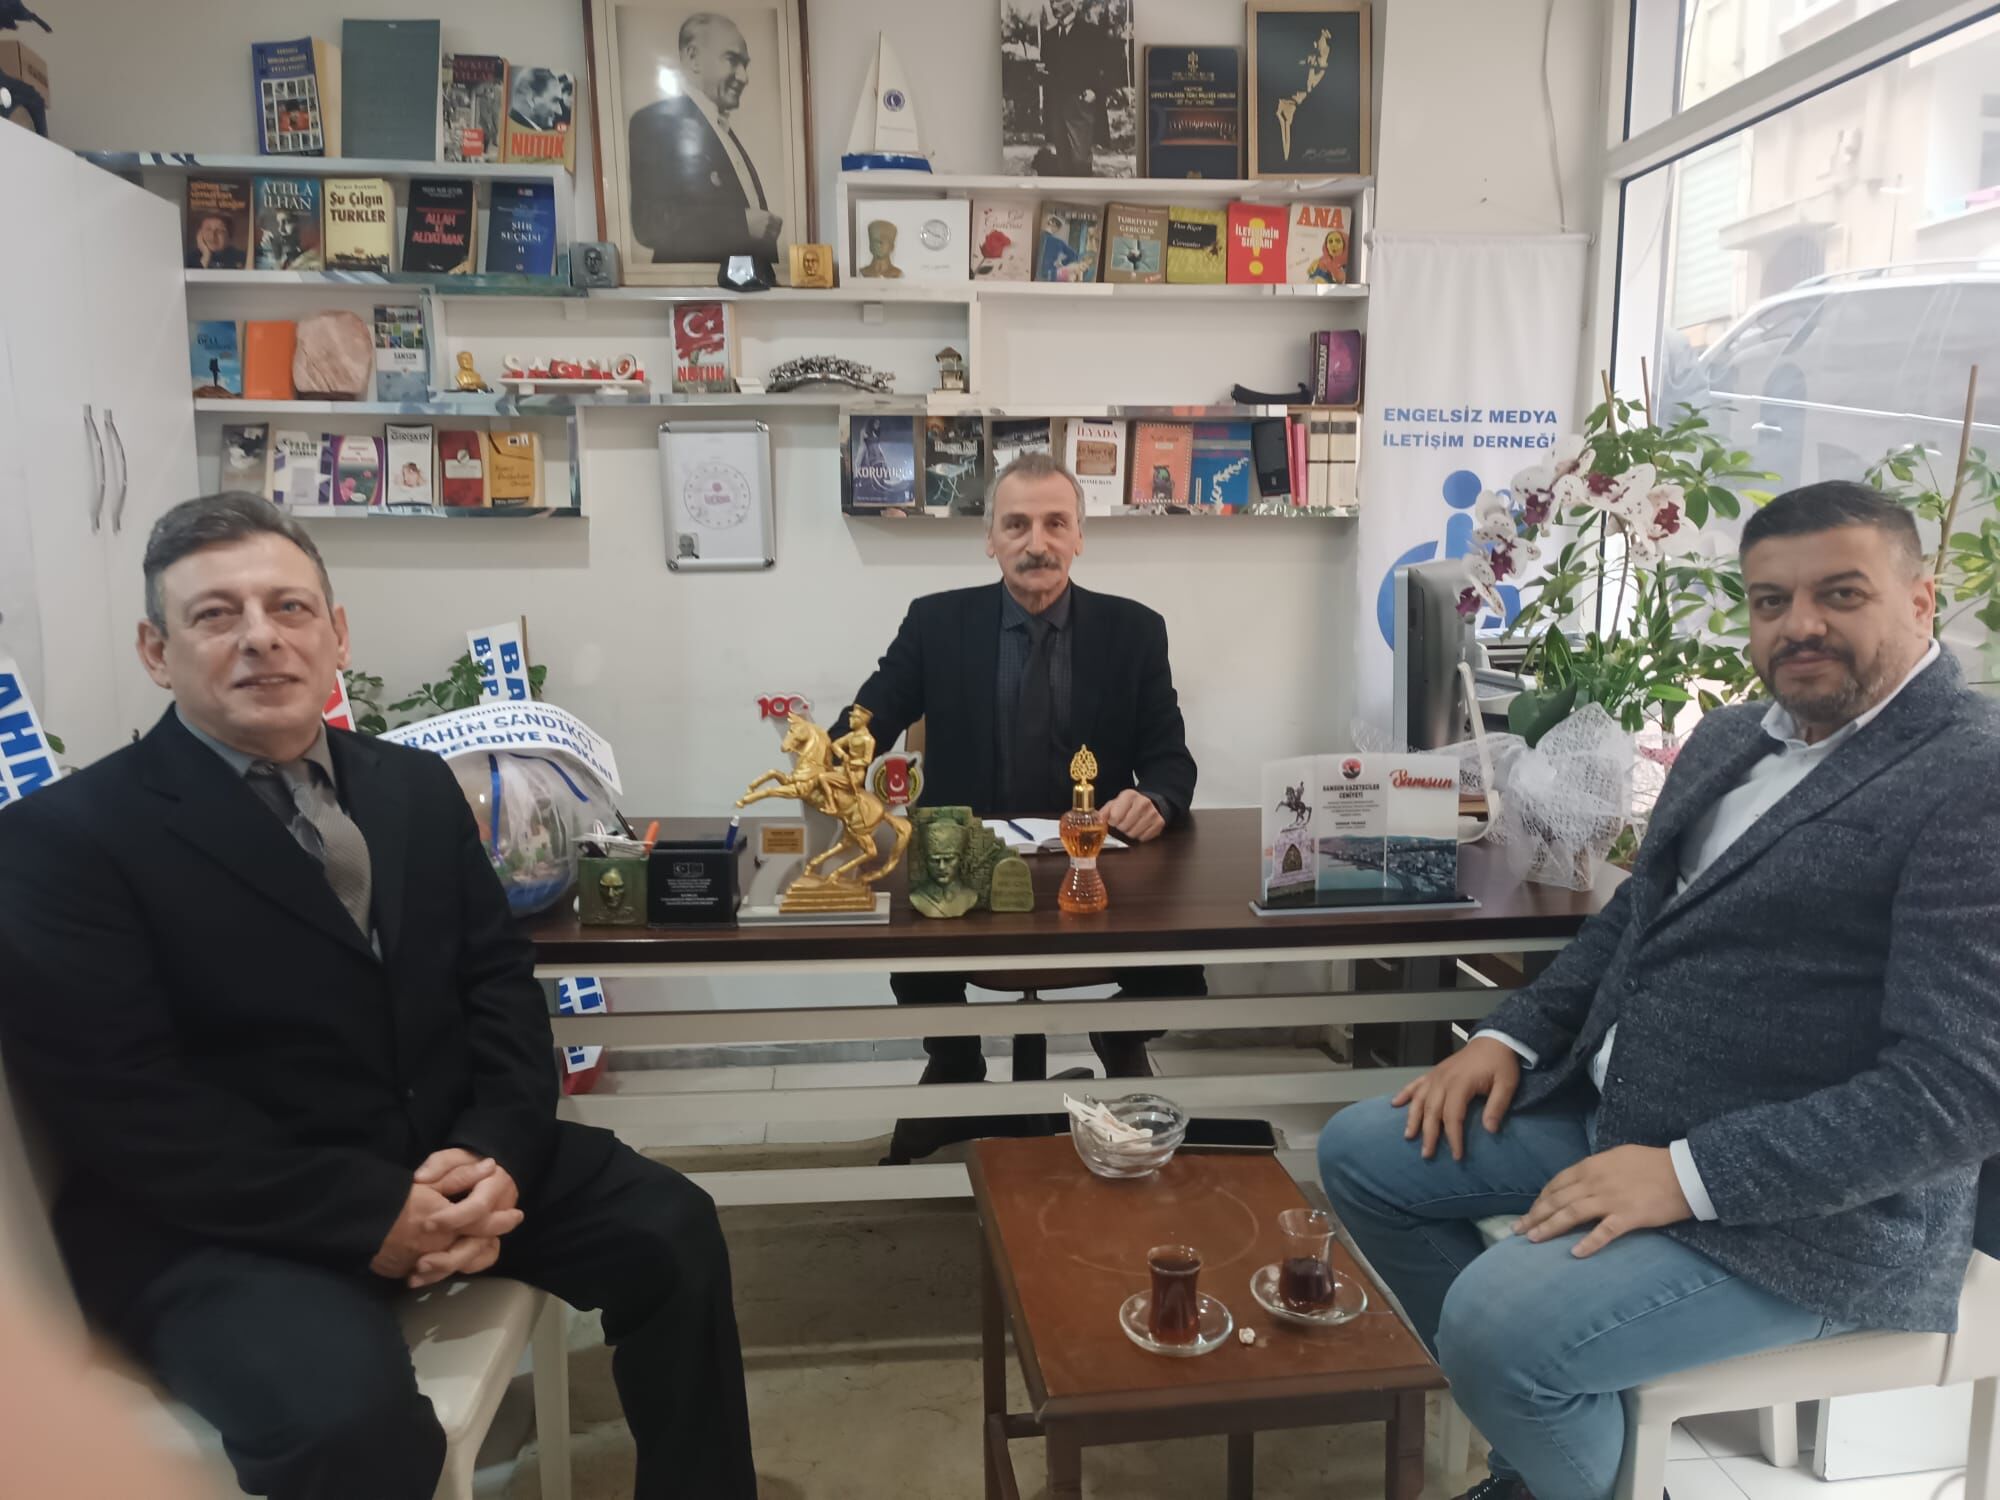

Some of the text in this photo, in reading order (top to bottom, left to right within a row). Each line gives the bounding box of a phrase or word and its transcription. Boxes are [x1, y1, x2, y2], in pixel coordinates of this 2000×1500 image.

[511, 133, 564, 159] NUTUK
[349, 191, 384, 208] Çılgın
[1296, 207, 1345, 230] ANA
[1383, 405, 1557, 424] ENGELSİZ MEDYA
[1383, 430, 1464, 450] İLETİŞİM
[1388, 769, 1456, 790] Samsun
